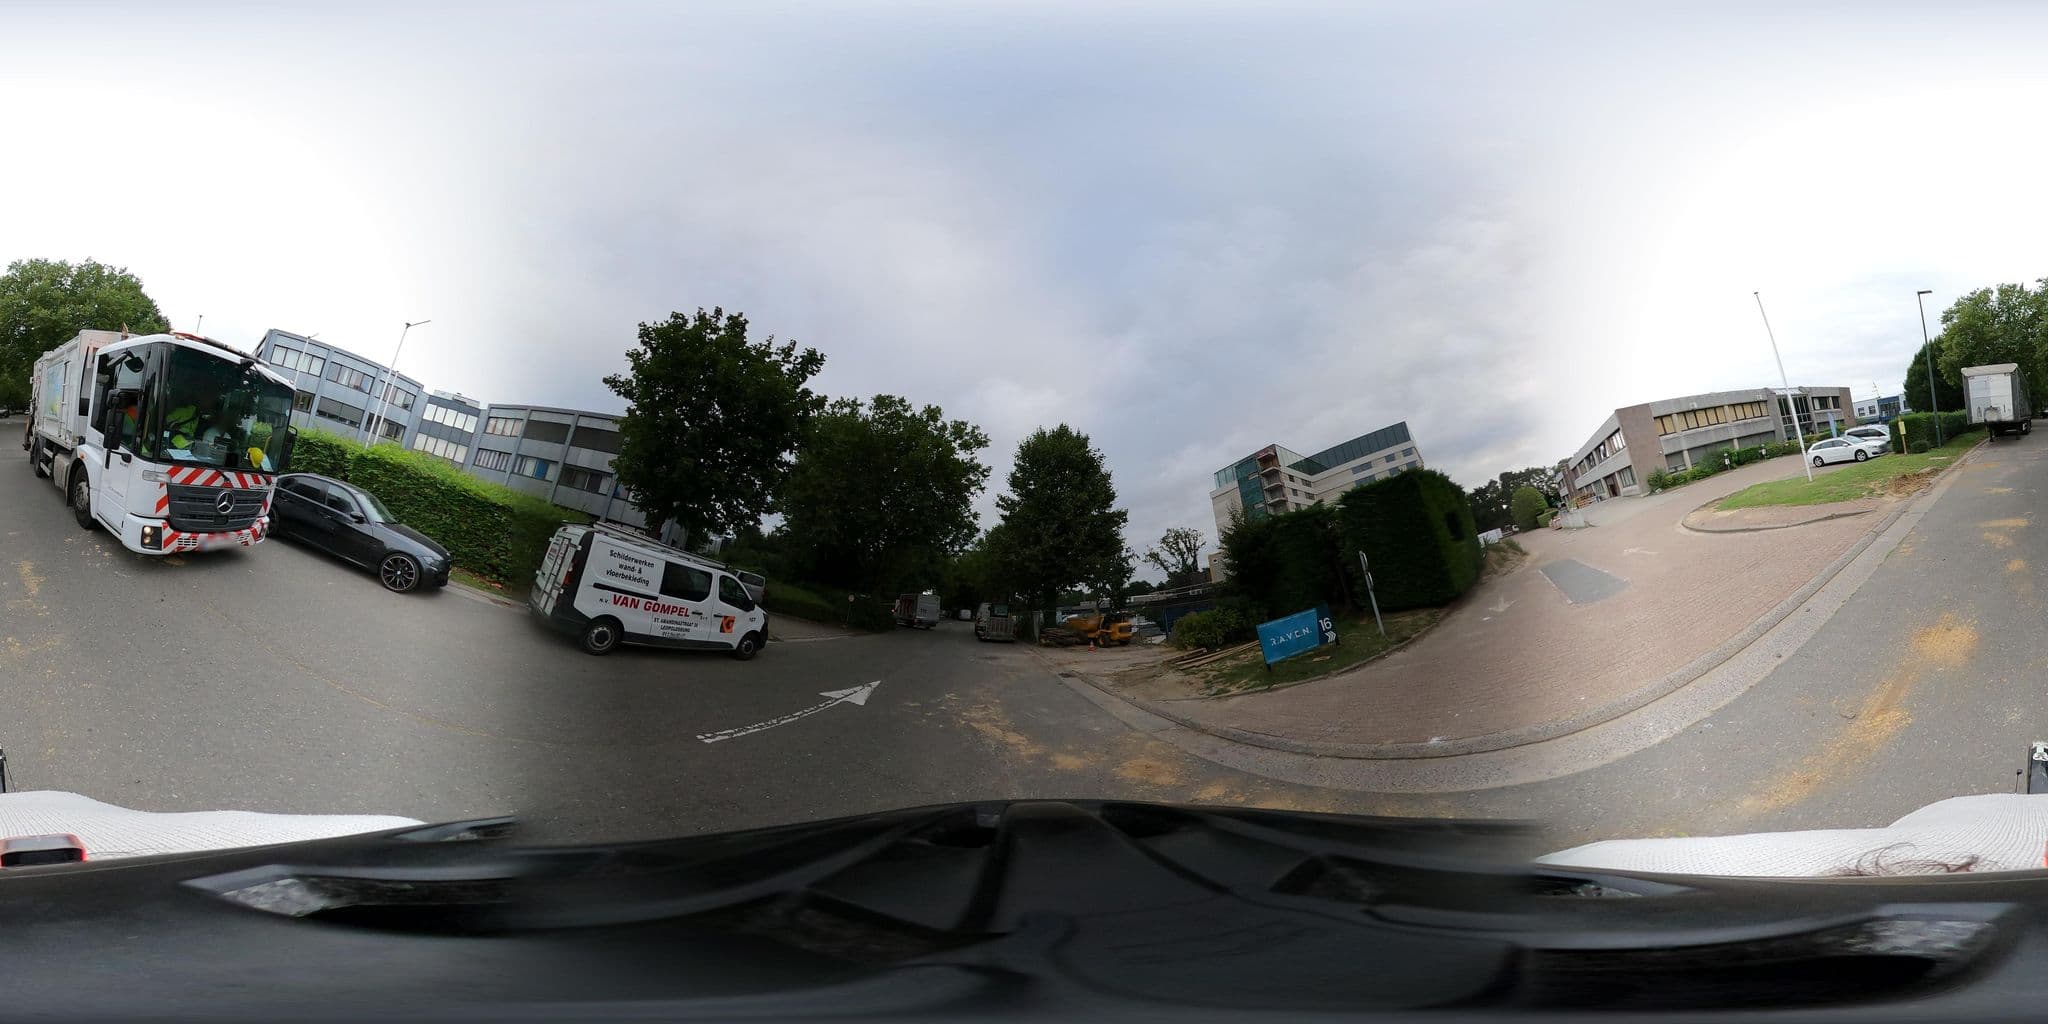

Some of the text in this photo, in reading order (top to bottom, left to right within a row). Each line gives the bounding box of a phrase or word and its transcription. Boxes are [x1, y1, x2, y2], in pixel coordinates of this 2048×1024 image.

[609, 549, 655, 568] Schilderwerken
[606, 568, 650, 587] vloerbekleding
[612, 594, 640, 609] VAN
[643, 601, 690, 618] GOMPEL
[1318, 617, 1333, 632] 16
